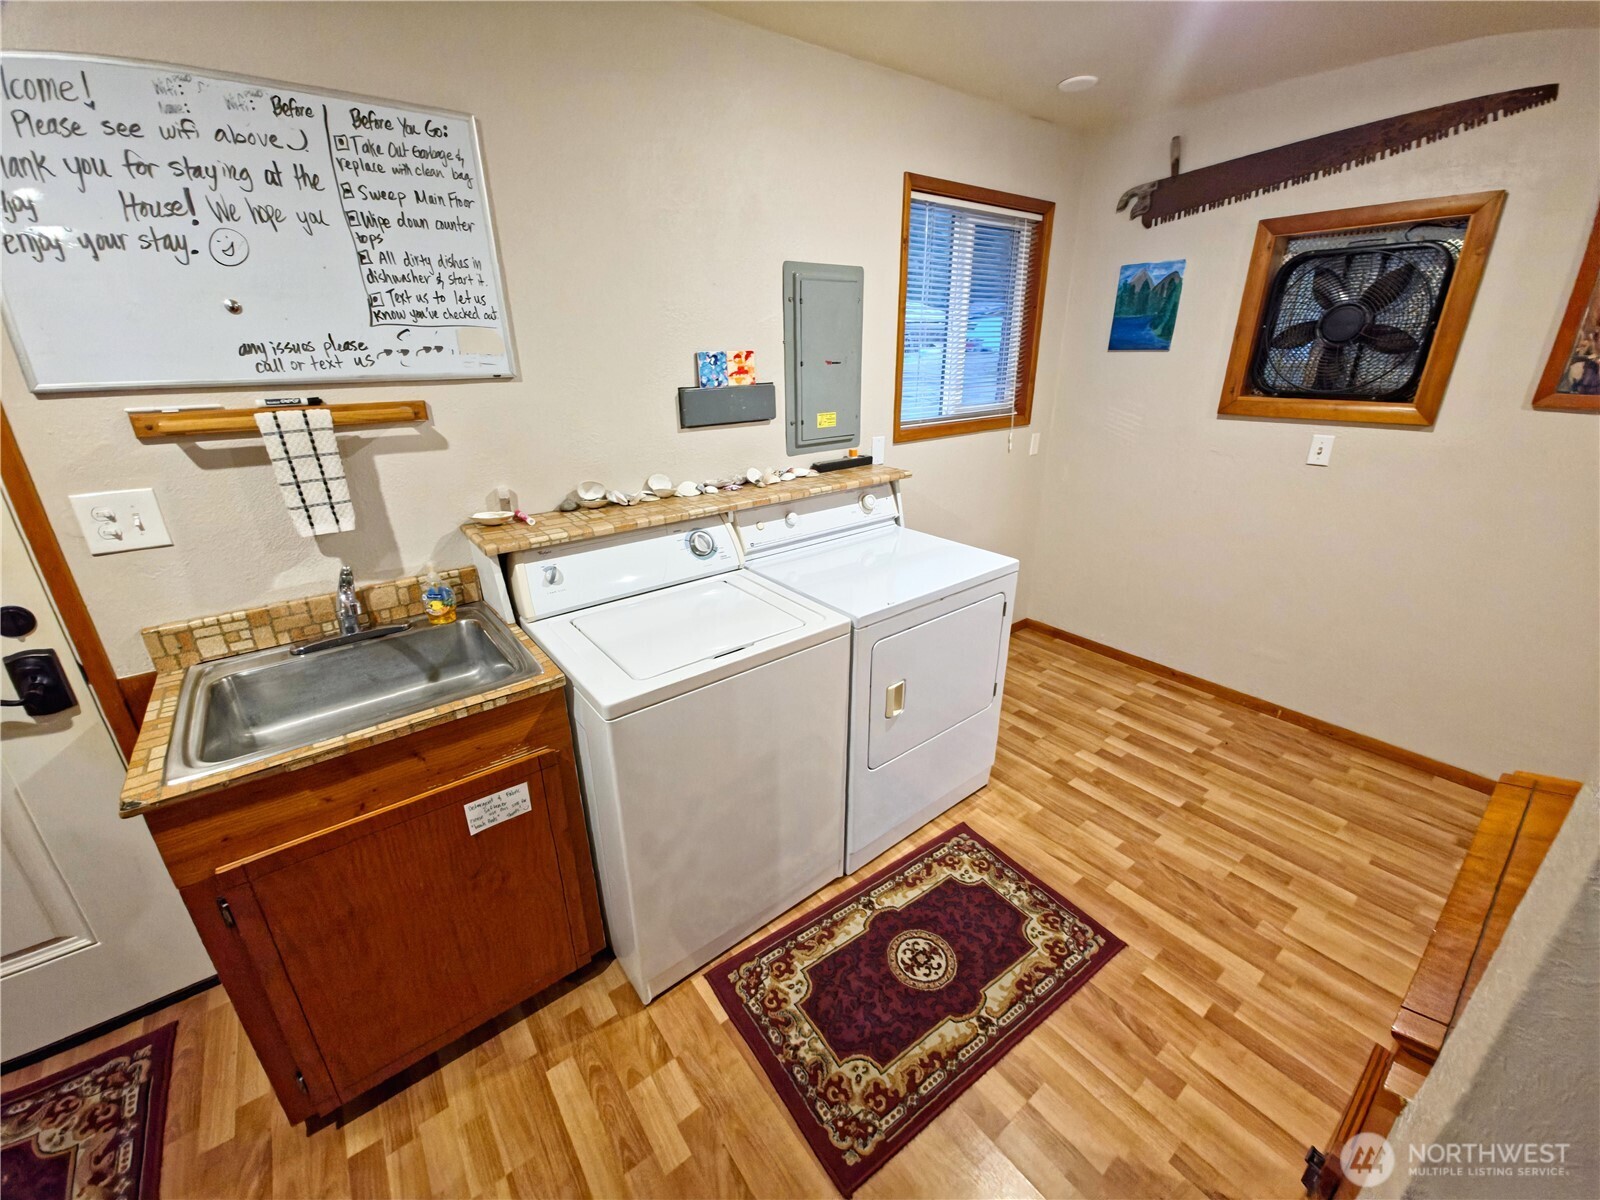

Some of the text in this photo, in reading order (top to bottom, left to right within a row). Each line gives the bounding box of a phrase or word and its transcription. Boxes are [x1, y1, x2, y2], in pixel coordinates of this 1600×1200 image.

[271, 95, 314, 118] Before
[10, 109, 285, 150] Please see wifi above
[349, 107, 449, 138] Before You Go:
[350, 135, 384, 157] Take
[388, 142, 409, 158] Out
[412, 145, 453, 168] Garbage
[62, 156, 112, 193] you
[121, 149, 159, 180] for
[169, 155, 252, 192] staying
[264, 161, 283, 188] at
[294, 163, 325, 192] the
[335, 157, 474, 189] replace with clean bag
[358, 185, 475, 209] Sweep Main Floor
[118, 187, 200, 226] House!
[205, 194, 242, 224] We
[244, 197, 288, 233] hope
[296, 210, 330, 237] you
[360, 211, 476, 233] Wipe down counter
[3, 226, 200, 265] enjoy your stay.
[355, 230, 385, 250] tops
[379, 250, 482, 275] All dirty dishes in
[366, 269, 430, 286] dishwasher
[448, 271, 475, 287] start
[386, 288, 487, 307] Text us to let us
[412, 307, 440, 324] you've
[443, 307, 480, 321] checked
[484, 309, 499, 321] out
[238, 333, 368, 362] any issues please
[255, 352, 376, 373] call or text us
